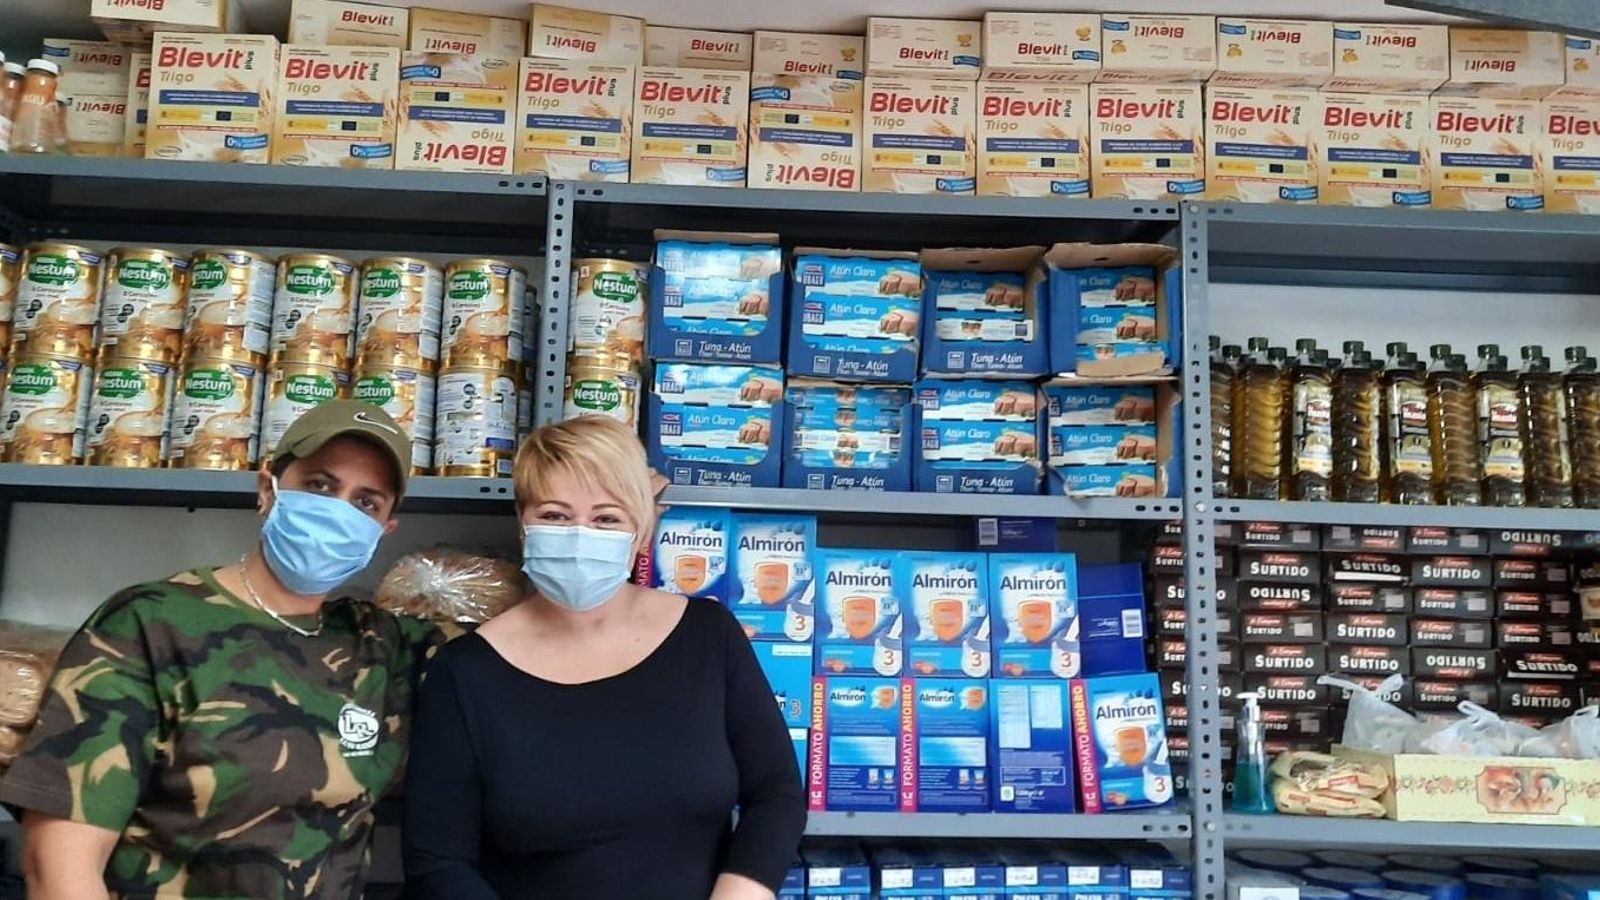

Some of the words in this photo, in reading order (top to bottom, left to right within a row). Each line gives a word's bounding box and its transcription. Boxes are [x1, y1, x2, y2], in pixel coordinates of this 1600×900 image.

[342, 11, 388, 26] Blevit
[1140, 27, 1184, 38] Blevit
[1257, 31, 1301, 43] Blevit
[432, 38, 476, 54] Blevit
[551, 36, 596, 53] Blevit
[691, 39, 734, 53] Blevit
[1372, 35, 1416, 47] Blevit
[900, 47, 941, 60] Blevit
[1018, 43, 1060, 55] Blevit
[158, 46, 245, 68] Blevit
[285, 59, 369, 81] Blevit
[784, 61, 827, 74] Blevit
[1471, 60, 1516, 71] Blevit
[160, 72, 194, 85] Trigo
[525, 72, 607, 95] Blevit
[287, 82, 320, 96] Trigo
[640, 81, 721, 104] Blevit
[527, 96, 560, 110] Trigo
[870, 92, 949, 115] Blevit
[983, 96, 1062, 118] Blevit
[1097, 98, 1175, 118] Blevit
[642, 105, 676, 119] Trigo
[1212, 101, 1291, 124] Blevit
[1324, 107, 1403, 128] Blevit
[872, 116, 905, 130] Trigo
[985, 120, 1018, 133] Trigo
[1100, 122, 1132, 135] Trigo
[1436, 111, 1515, 133] Blevit
[472, 130, 505, 142] Trigo
[1215, 125, 1247, 137] Trigo
[1328, 130, 1360, 143] Trigo
[1440, 135, 1471, 148] Trigo
[424, 143, 507, 166] Blevit
[775, 165, 855, 189] Blevit
[287, 275, 331, 287] Nestum
[594, 279, 637, 295] Nestum
[287, 383, 334, 397] Nestum
[574, 387, 617, 402] Nestum
[688, 414, 709, 425] Atún
[712, 414, 735, 425] Claro
[660, 531, 722, 547] Almirón
[738, 536, 805, 552] Almirón
[1502, 531, 1562, 547] SURTIDO
[1251, 562, 1309, 576] SURTIDO
[1343, 560, 1401, 573] SURTIDO
[1423, 565, 1480, 579] SURTIDO
[826, 571, 891, 587] Almirón
[912, 573, 977, 589] Almirón
[1000, 575, 1066, 590] Almirón
[1251, 587, 1310, 601] SURTIDO
[795, 616, 805, 631] 3
[1337, 624, 1395, 638] SURTIDO
[884, 651, 894, 666] 3
[972, 652, 982, 667] 3
[1061, 653, 1071, 667] 3
[1255, 655, 1314, 668] SURTIDO
[1340, 655, 1398, 670] SURTIDO
[1427, 655, 1486, 669] SURTIDO
[1517, 660, 1578, 673] SURTIDO
[830, 692, 866, 702] Almirón
[1257, 686, 1316, 700] SURTIDO
[1512, 693, 1571, 708] SURTIDO
[816, 682, 824, 731] AHORRO
[903, 684, 912, 732] AHORRO
[1072, 685, 1088, 734] AHORRO
[1096, 704, 1156, 720] Almirón
[813, 732, 824, 785] FORMATO
[903, 733, 914, 786] FORMATO
[1080, 735, 1095, 786] FORMATO
[1156, 777, 1165, 792] 3
